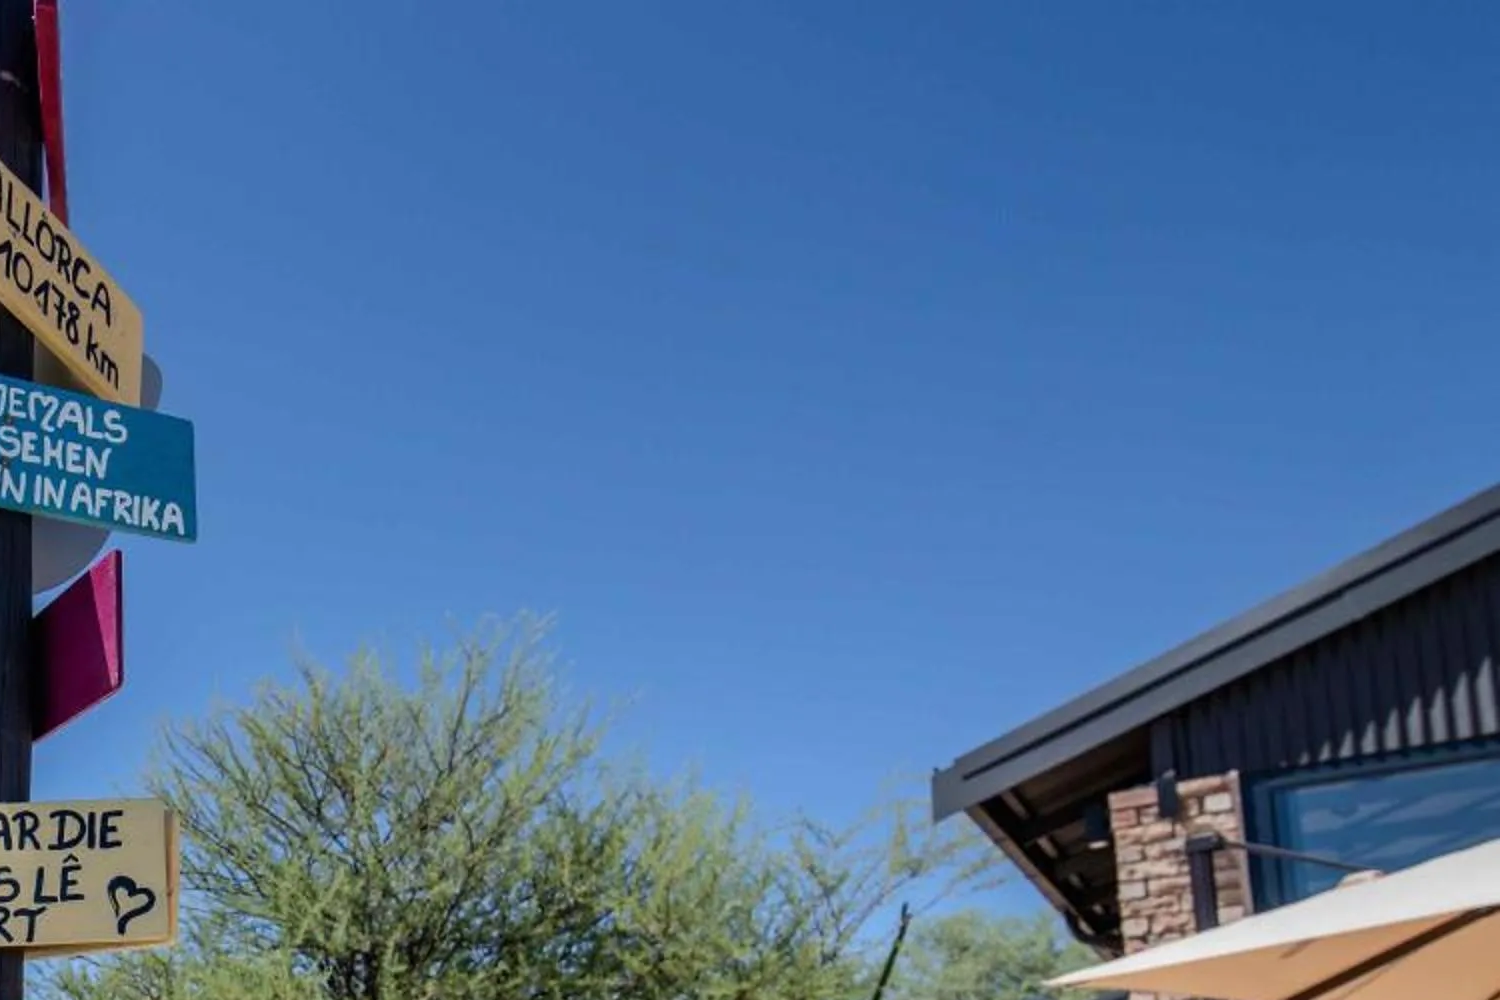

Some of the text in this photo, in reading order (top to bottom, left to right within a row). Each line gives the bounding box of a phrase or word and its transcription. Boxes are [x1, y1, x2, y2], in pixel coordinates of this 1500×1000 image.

[86, 324, 118, 390] km
[34, 475, 66, 508] IN
[70, 482, 185, 535] AFRIKA
[48, 810, 123, 852] DIE
[33, 853, 85, 902] LÊ
